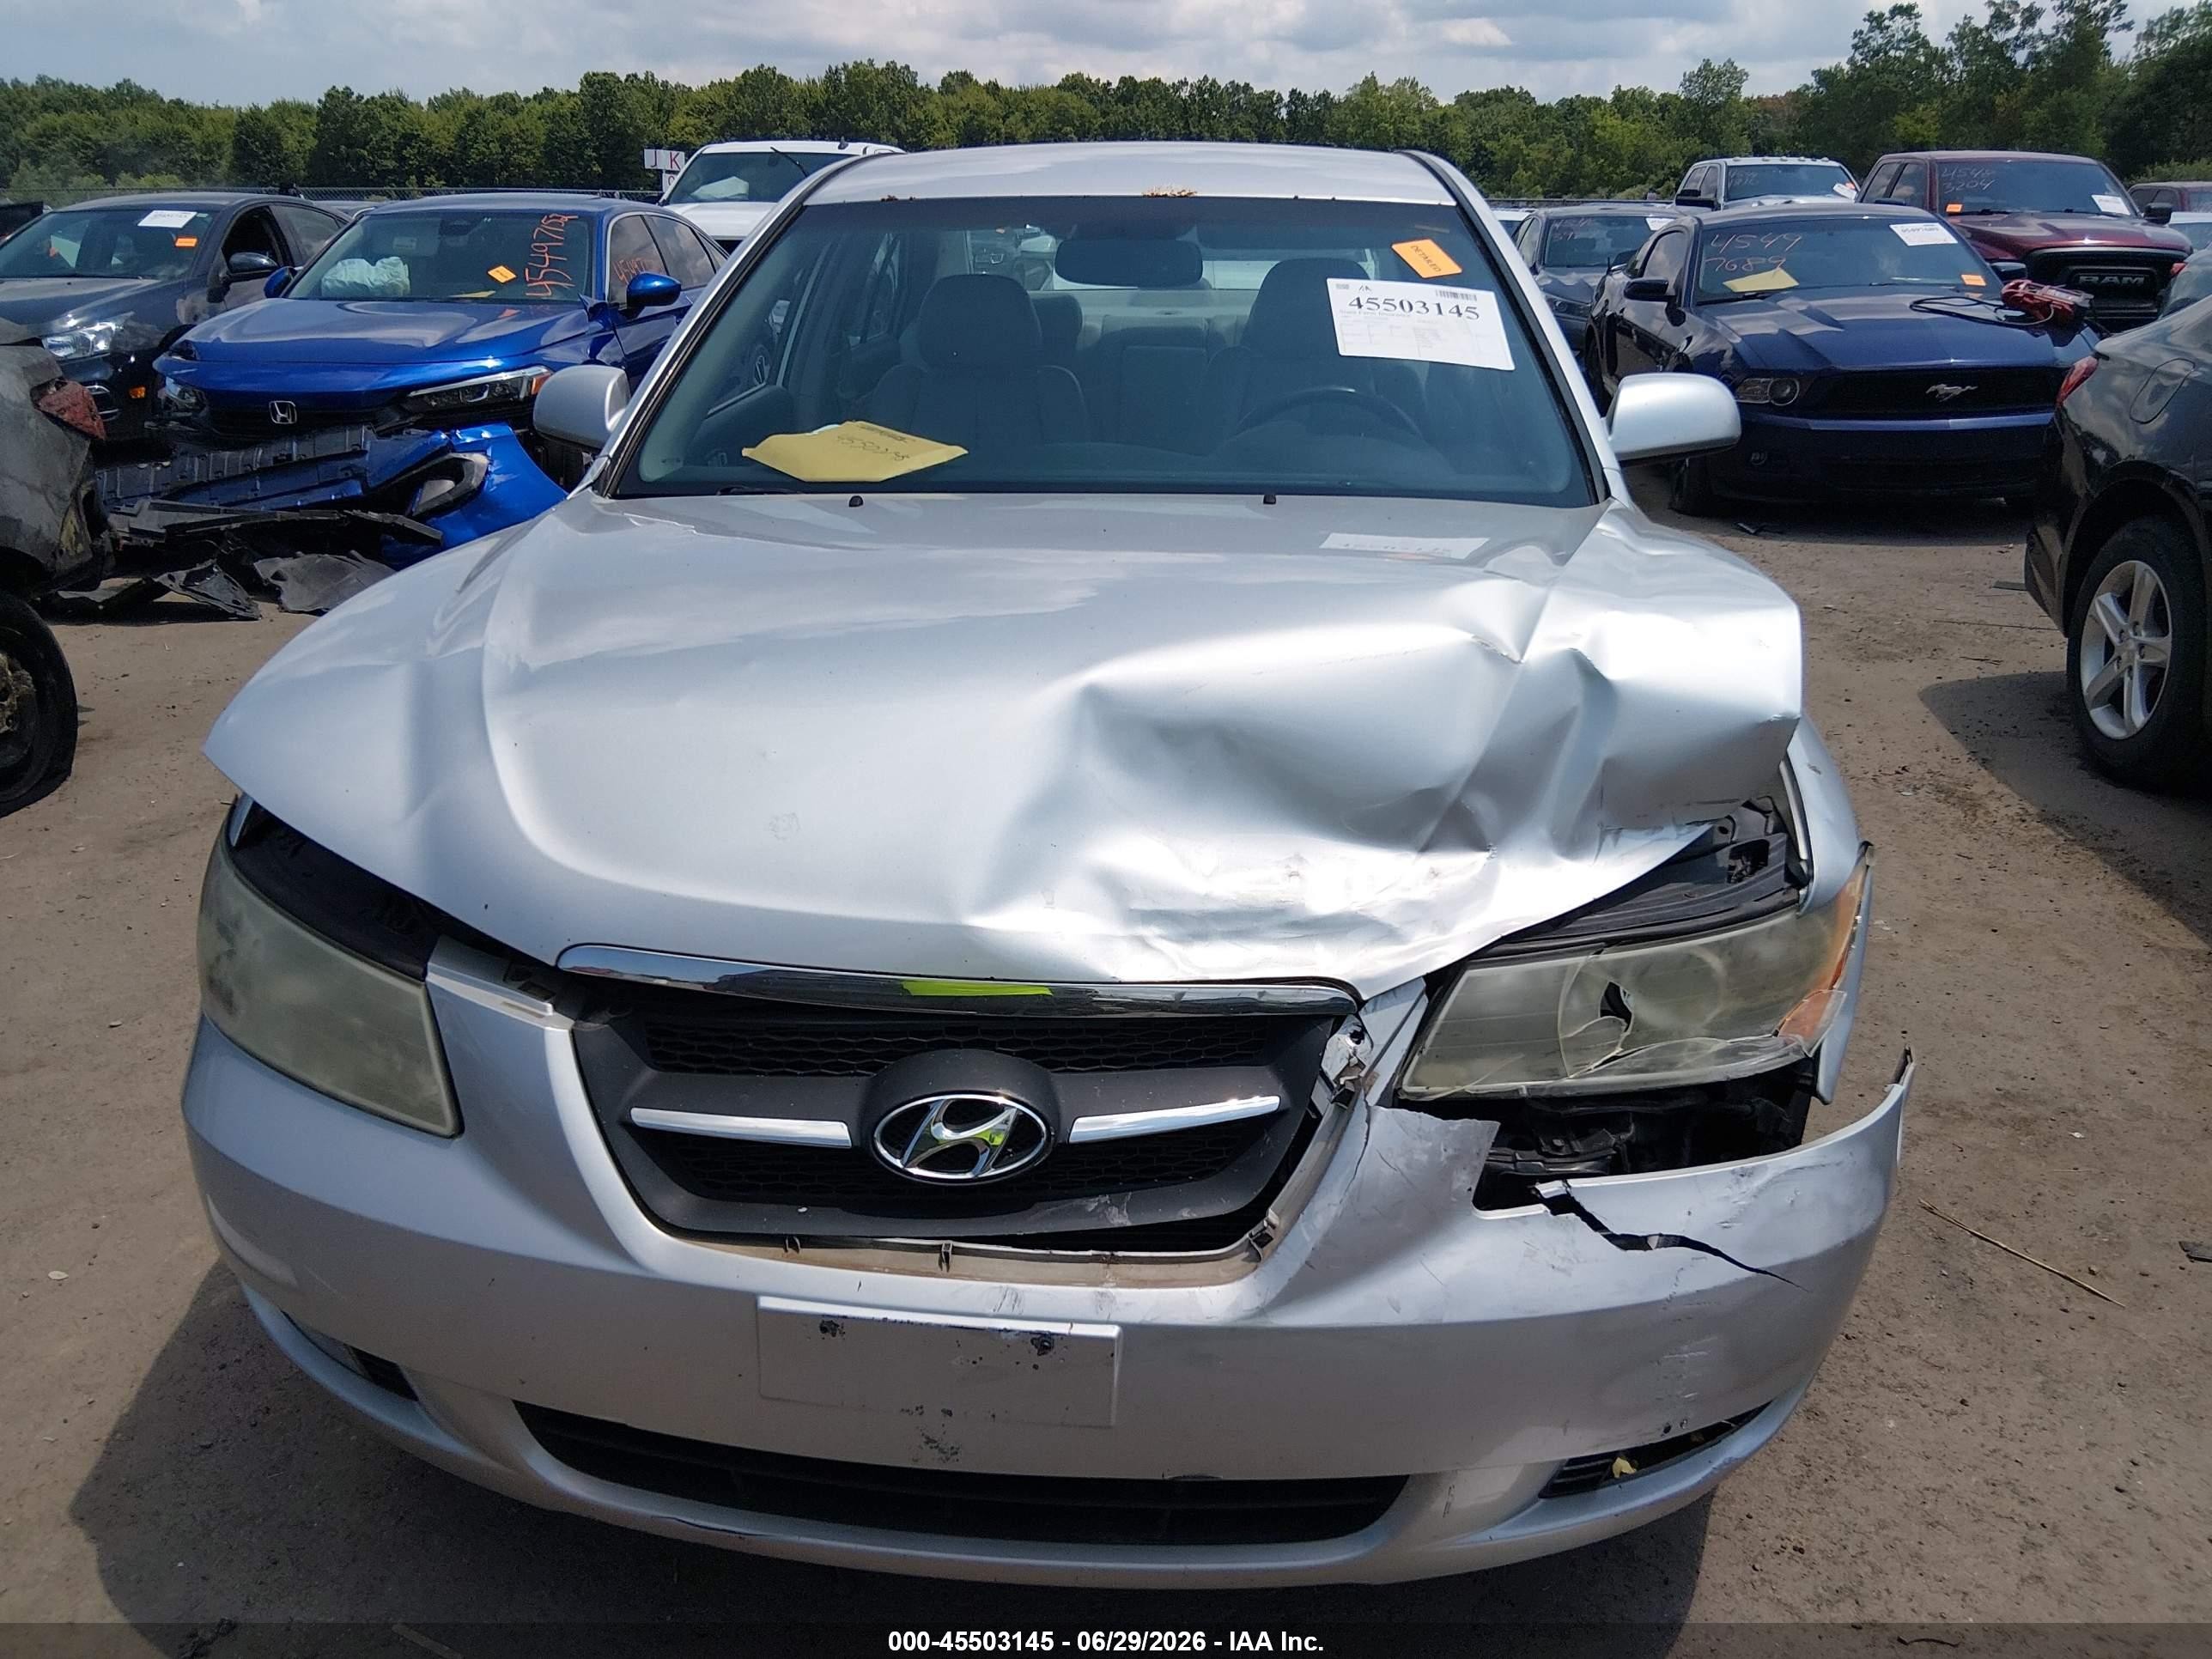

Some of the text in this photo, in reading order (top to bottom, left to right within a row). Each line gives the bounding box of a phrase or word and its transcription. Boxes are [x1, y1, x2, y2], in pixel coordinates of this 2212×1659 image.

[651, 150, 681, 170] J K
[1711, 232, 1802, 253] 4549
[1703, 257, 1786, 272] 7689
[2078, 275, 2145, 285] RAM
[1348, 295, 1480, 320] 45503145
